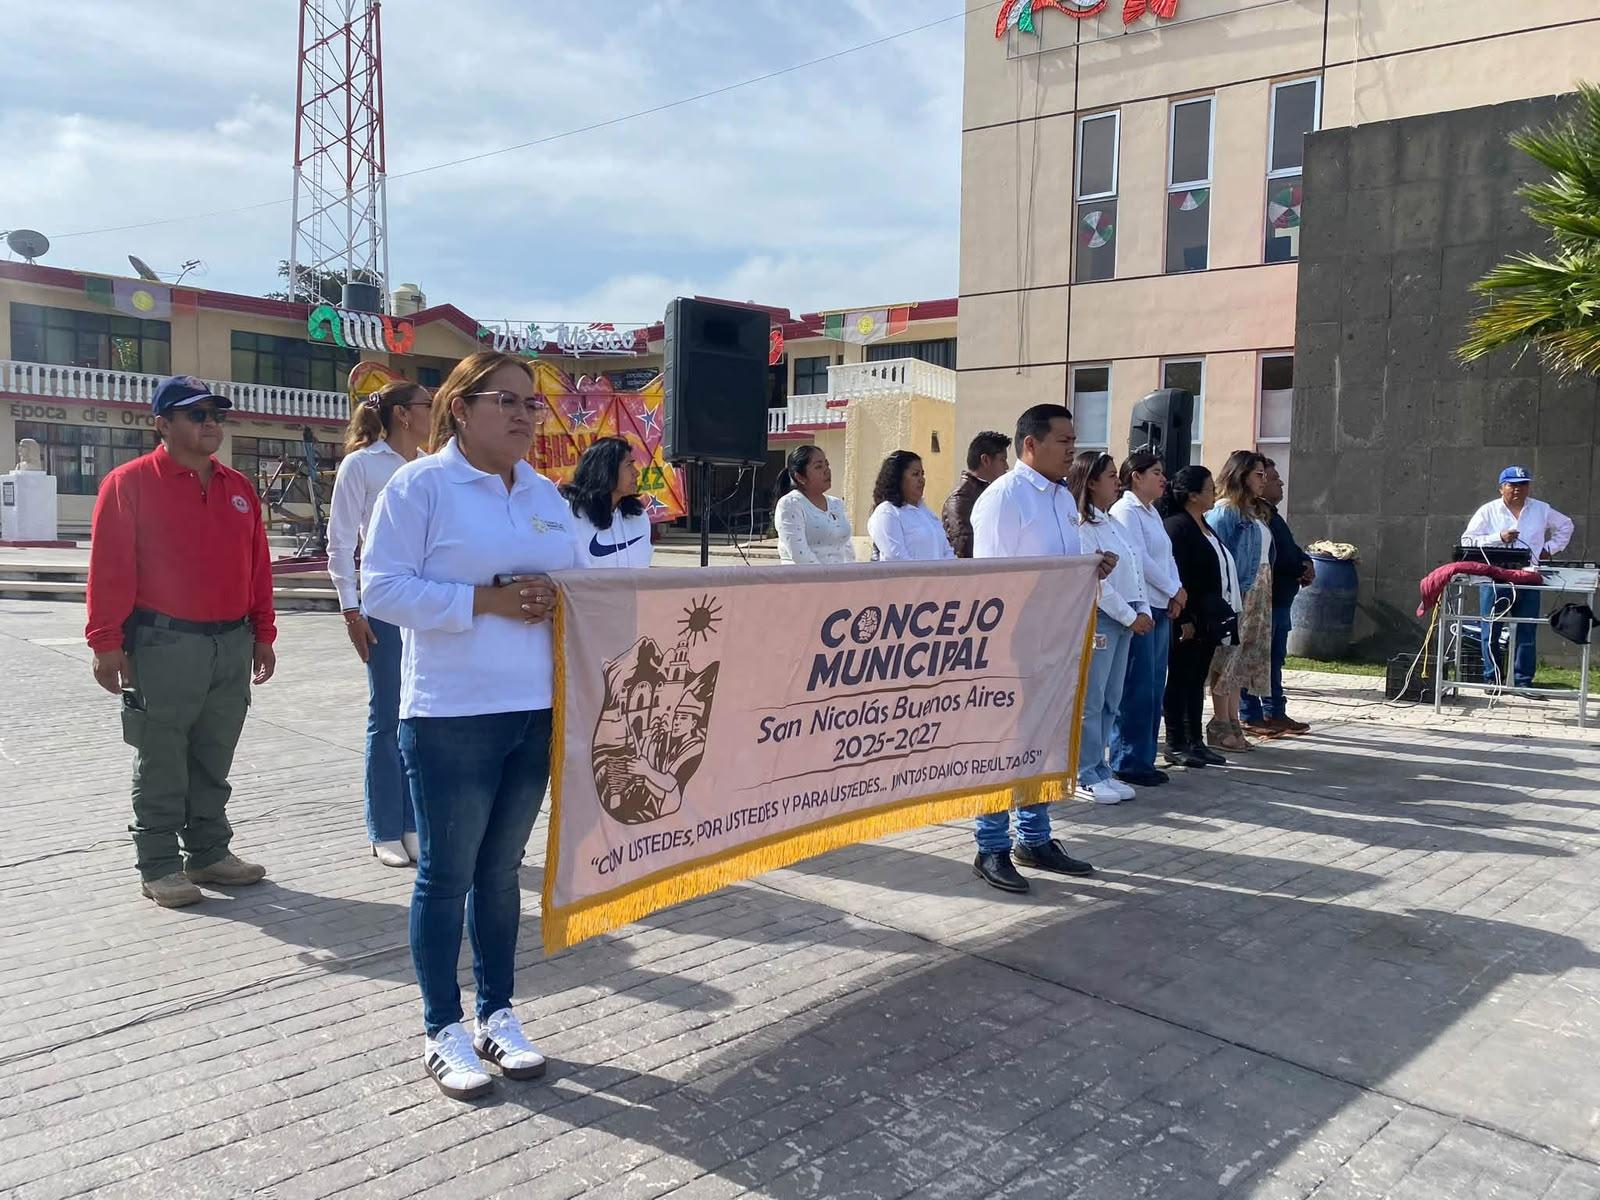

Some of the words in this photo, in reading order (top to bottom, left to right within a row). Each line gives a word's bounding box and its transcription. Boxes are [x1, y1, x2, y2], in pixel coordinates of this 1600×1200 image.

[489, 319, 547, 353] Viva
[82, 407, 108, 423] de
[820, 597, 1005, 648] CONCEJO
[806, 637, 989, 691] MUNICIPAL
[757, 716, 802, 744] San
[809, 698, 889, 735] Nicolás
[892, 694, 961, 720] Buenos
[964, 685, 1015, 710] Aires
[833, 721, 942, 762] 2025-2027
[628, 828, 695, 862] USTEDES,
[696, 817, 722, 843] POR
[725, 801, 779, 832] USTEDES
[782, 797, 790, 815] Y
[792, 788, 828, 813] PARA
